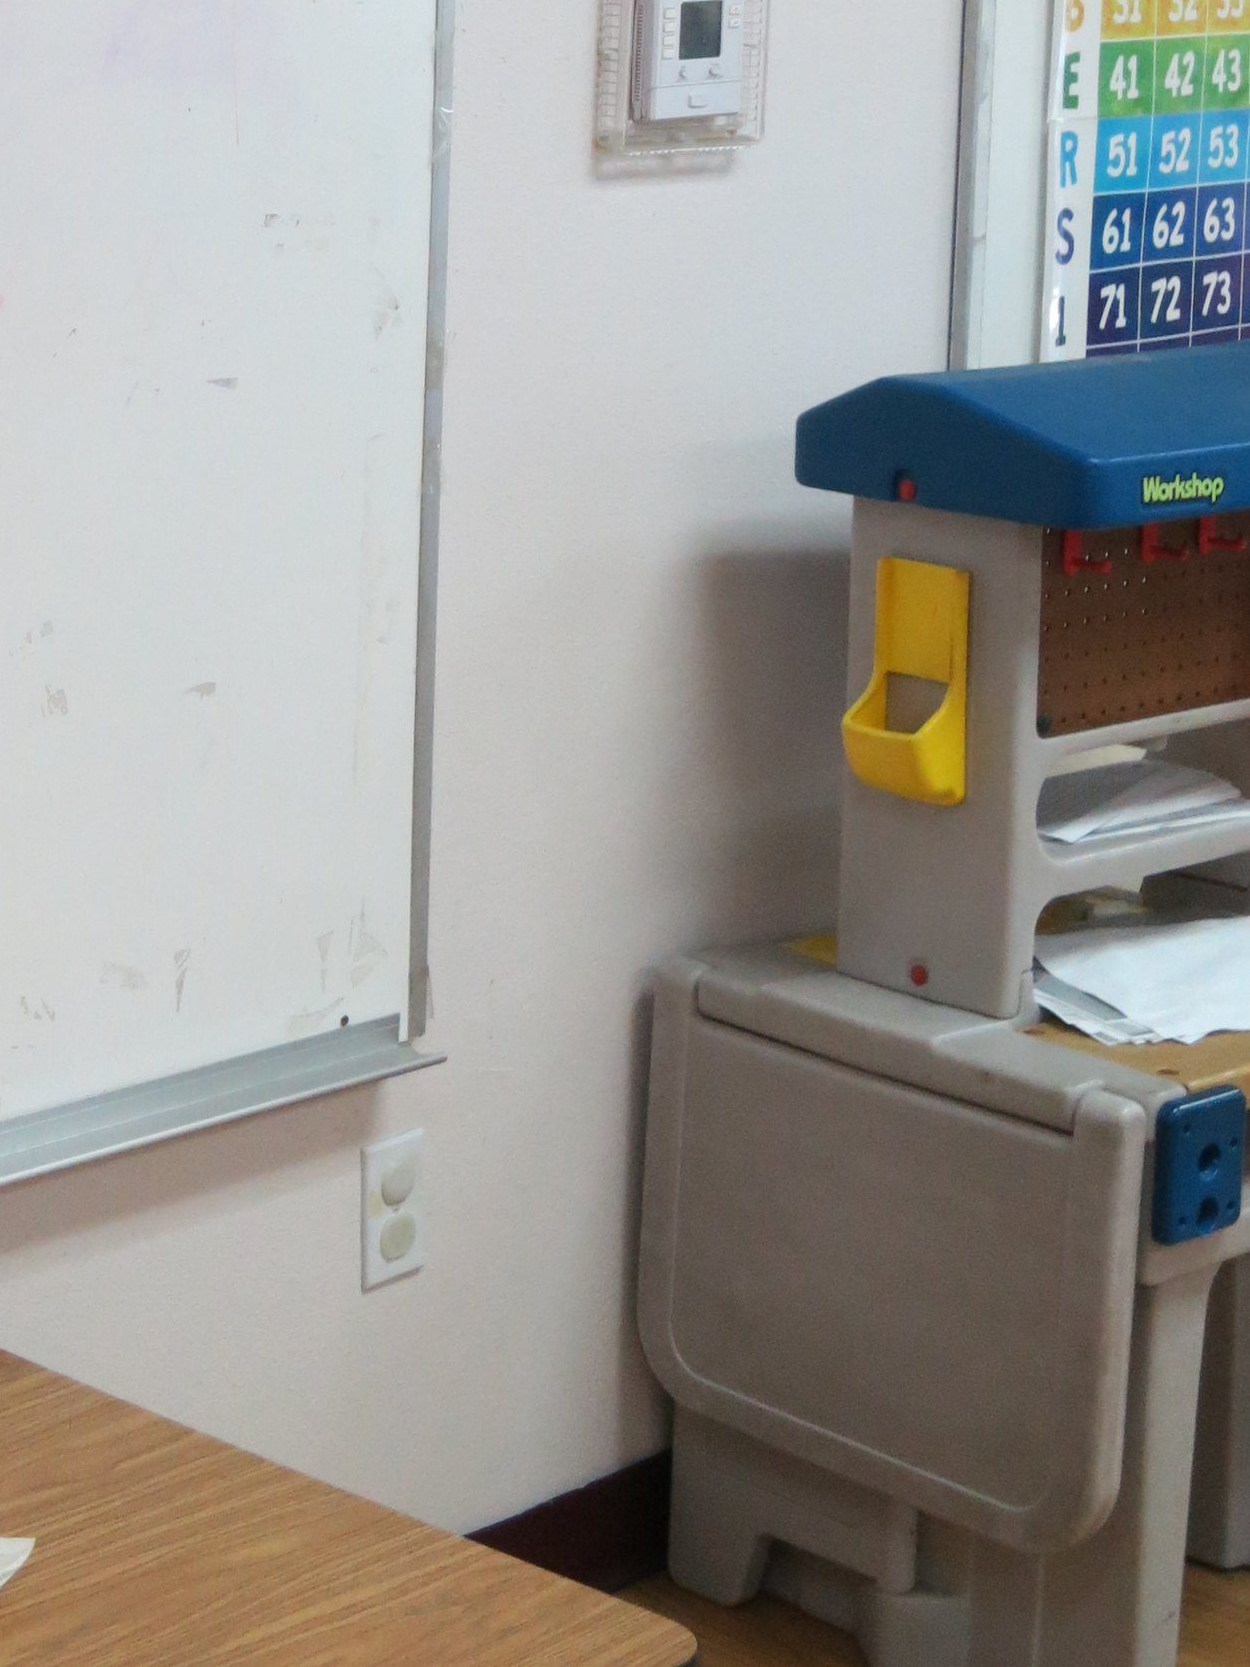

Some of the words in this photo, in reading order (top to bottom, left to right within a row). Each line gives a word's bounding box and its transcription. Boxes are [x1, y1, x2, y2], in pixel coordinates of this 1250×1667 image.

[1110, 54, 1139, 100] 41
[1164, 50, 1195, 98] 42
[1212, 48, 1242, 93] 43
[1107, 132, 1138, 177] 51
[1159, 128, 1192, 174] 52
[1208, 124, 1239, 169] 53
[1102, 207, 1131, 254] 61
[1152, 201, 1185, 250] 62
[1203, 197, 1235, 244] 63
[1099, 283, 1127, 330] 71
[1151, 276, 1181, 324] 72
[1202, 270, 1231, 317] 73
[1142, 471, 1225, 504] Workshop
